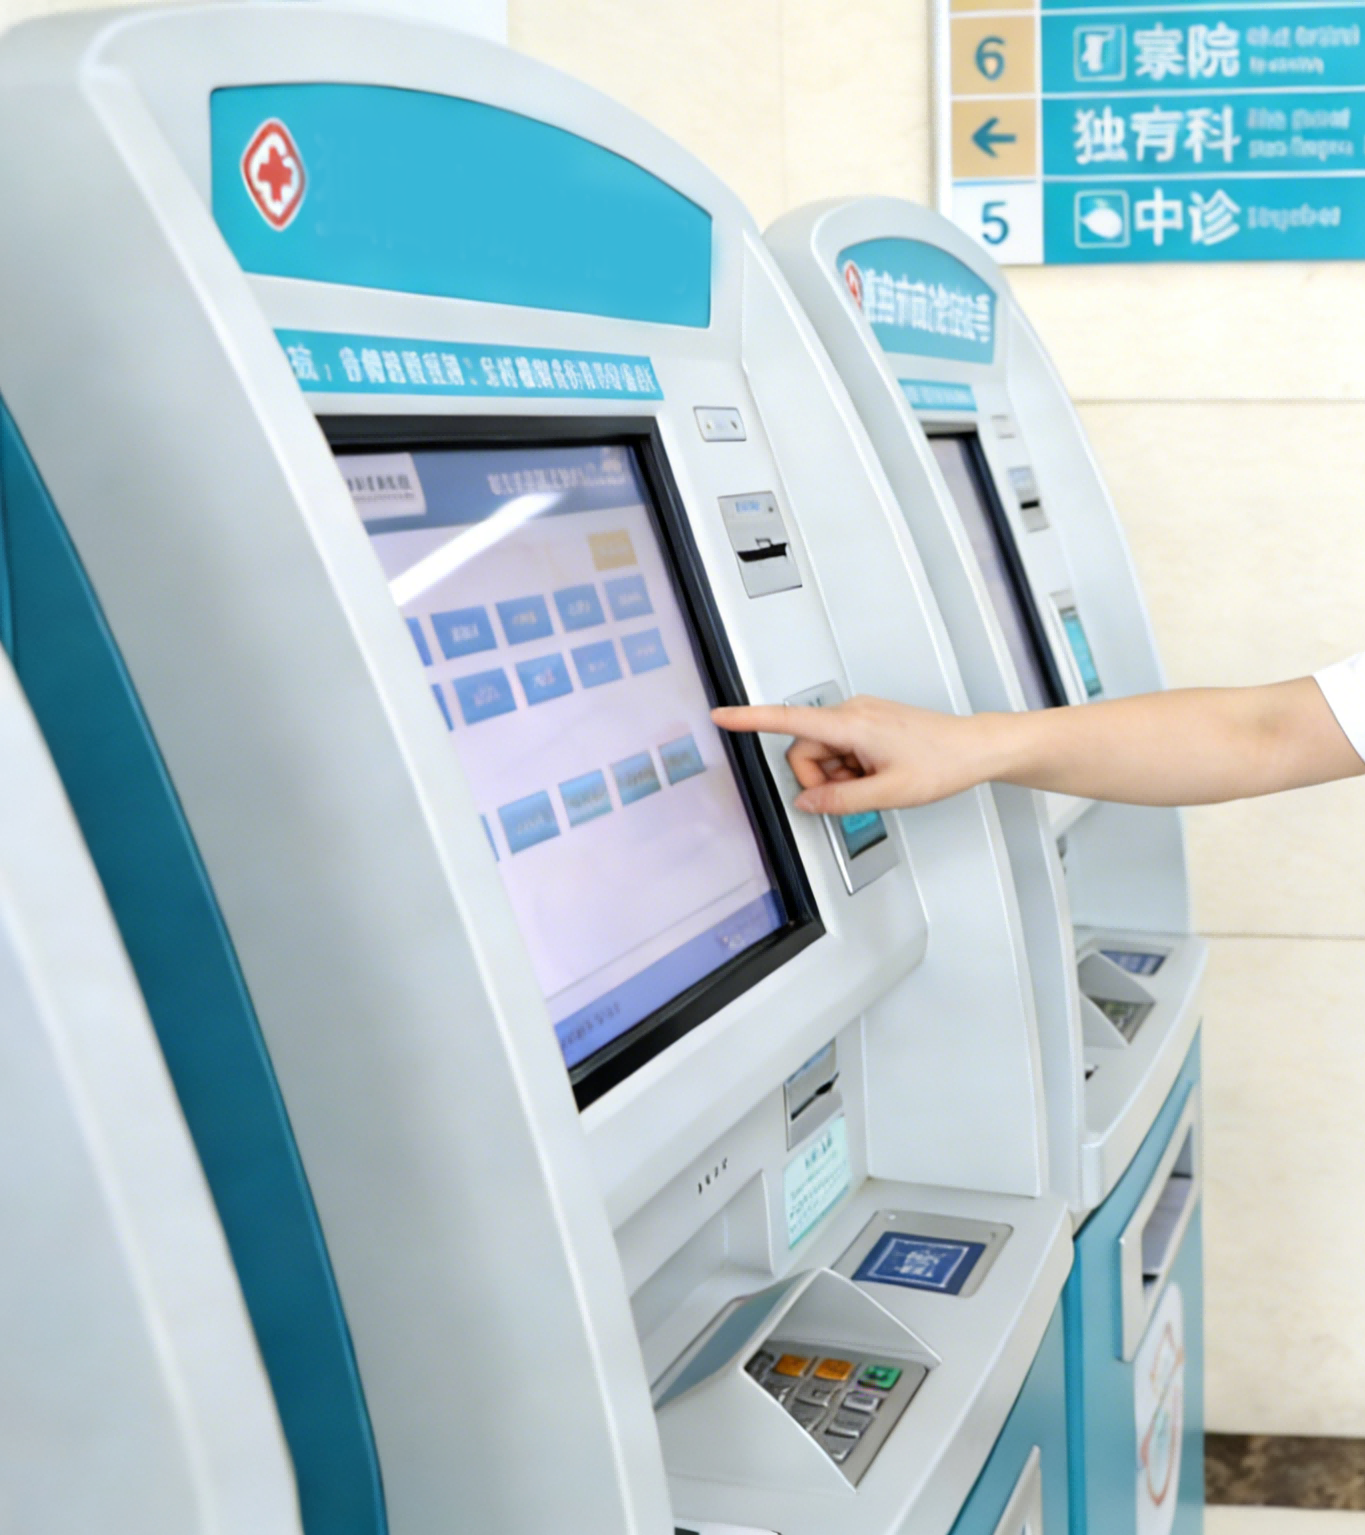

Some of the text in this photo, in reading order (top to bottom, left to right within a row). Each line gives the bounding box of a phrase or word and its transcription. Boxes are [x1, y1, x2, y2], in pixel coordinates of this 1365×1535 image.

[974, 35, 1005, 81] 6
[982, 201, 1010, 245] 5
[1134, 186, 1241, 246] 中诊
